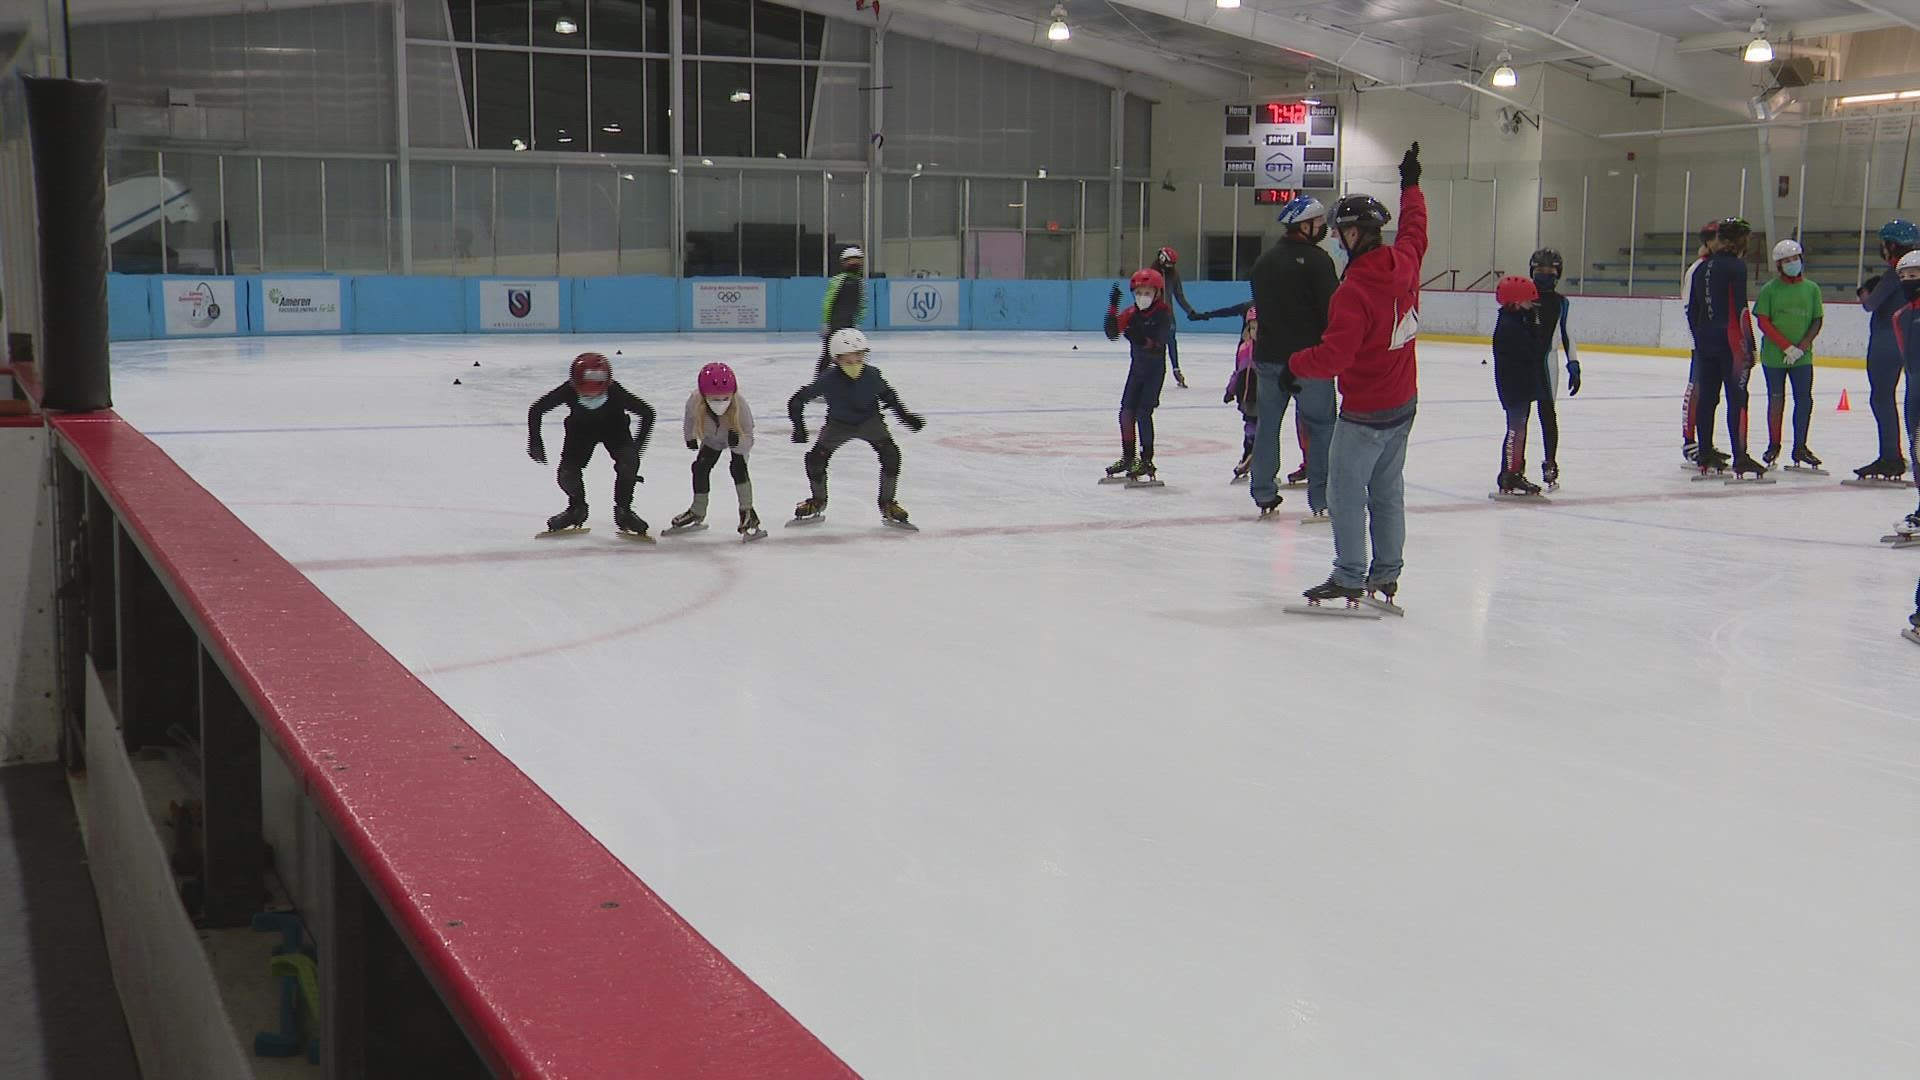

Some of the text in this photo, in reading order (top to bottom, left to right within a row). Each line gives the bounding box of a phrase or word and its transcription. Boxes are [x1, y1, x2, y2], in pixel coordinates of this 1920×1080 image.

[1268, 104, 1306, 124] 7:42
[1268, 135, 1291, 144] period
[1306, 163, 1331, 172] penalty
[1705, 260, 1715, 320] GATEWAY
[279, 297, 311, 307] Ameren
[912, 292, 936, 319] ISU
